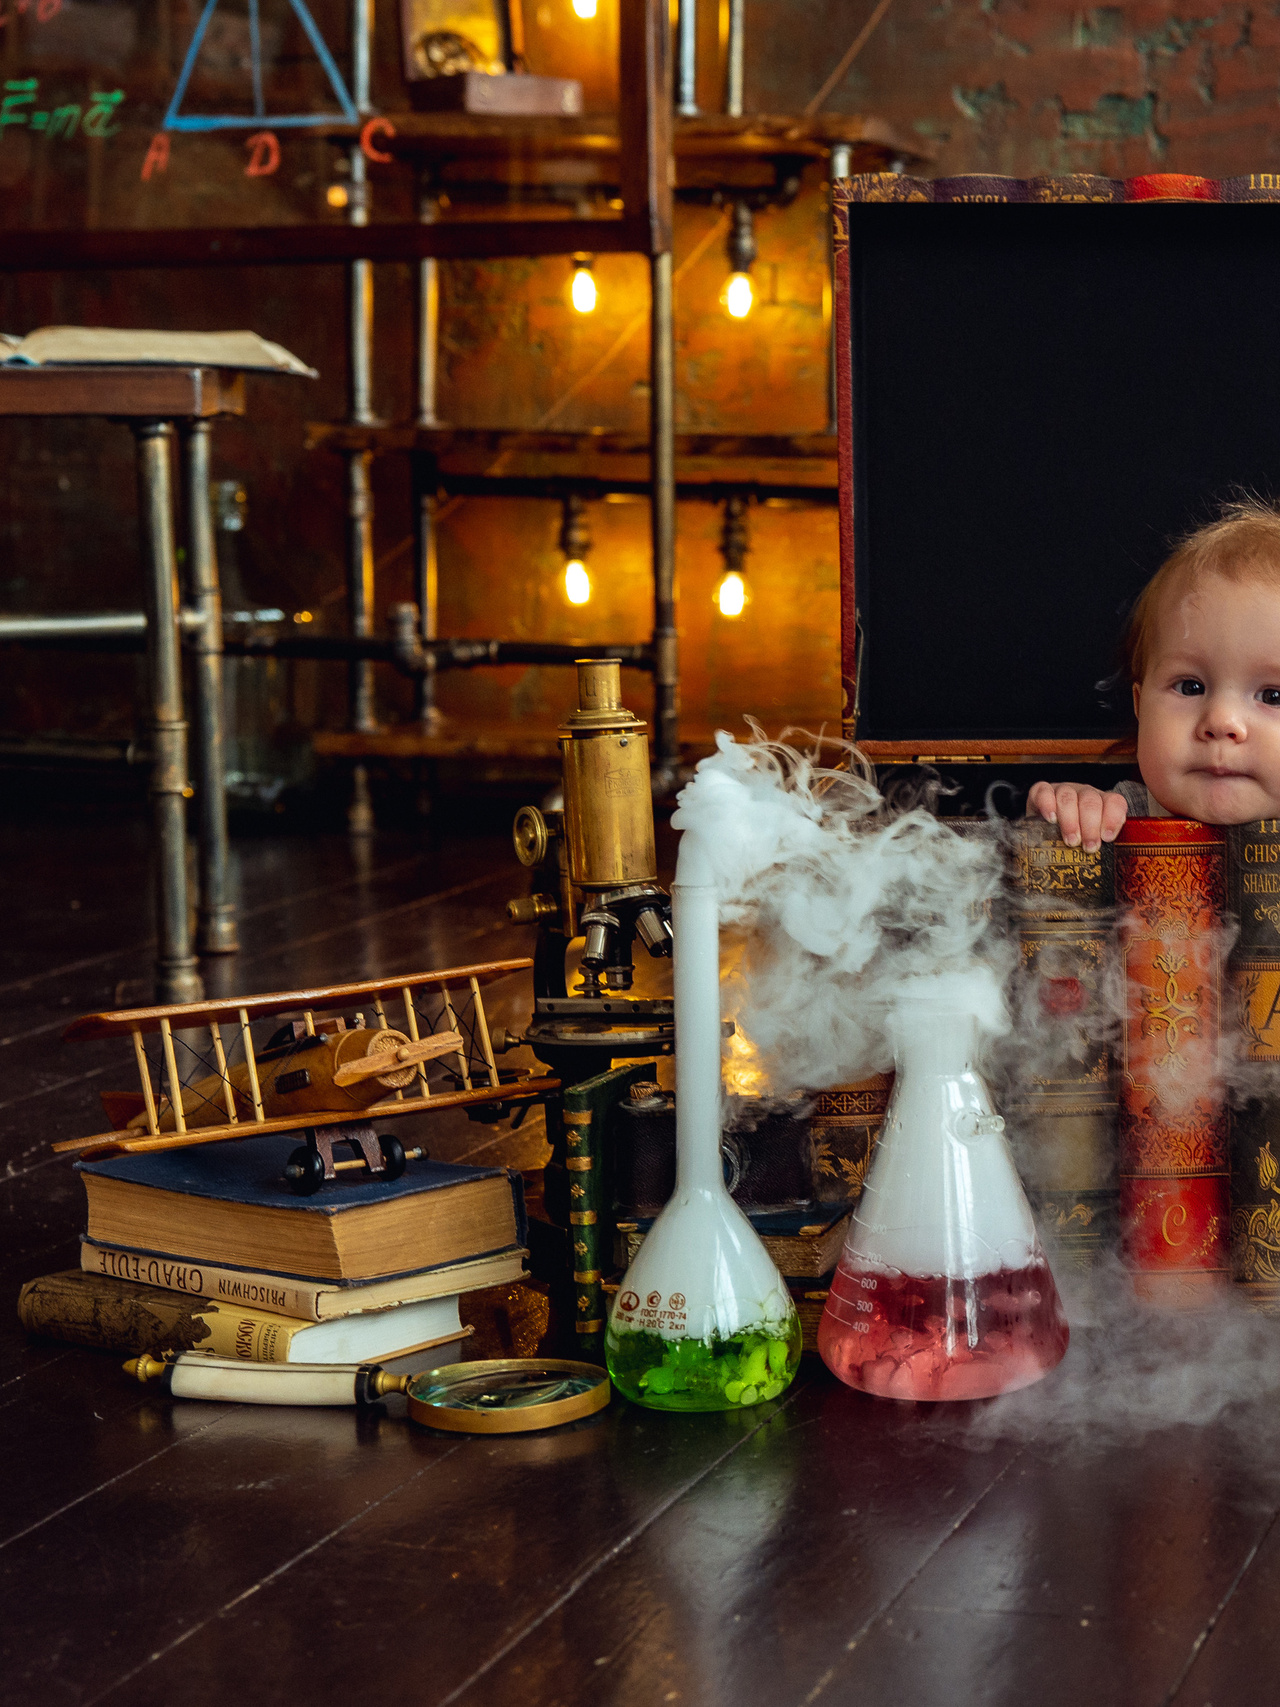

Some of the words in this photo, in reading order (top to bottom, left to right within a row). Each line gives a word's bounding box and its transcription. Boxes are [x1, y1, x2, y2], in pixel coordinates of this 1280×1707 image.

[141, 133, 170, 181] A
[244, 131, 280, 176] D
[361, 117, 396, 164] C
[1162, 1204, 1188, 1247] C
[98, 1250, 204, 1294] GRAU-EULE
[860, 1277, 878, 1290] 600
[218, 1278, 287, 1308] PRISCHWIN
[856, 1300, 874, 1313] 500
[641, 1308, 658, 1318] ГОСТ
[660, 1310, 687, 1320] 1770-74
[852, 1321, 870, 1334] 400
